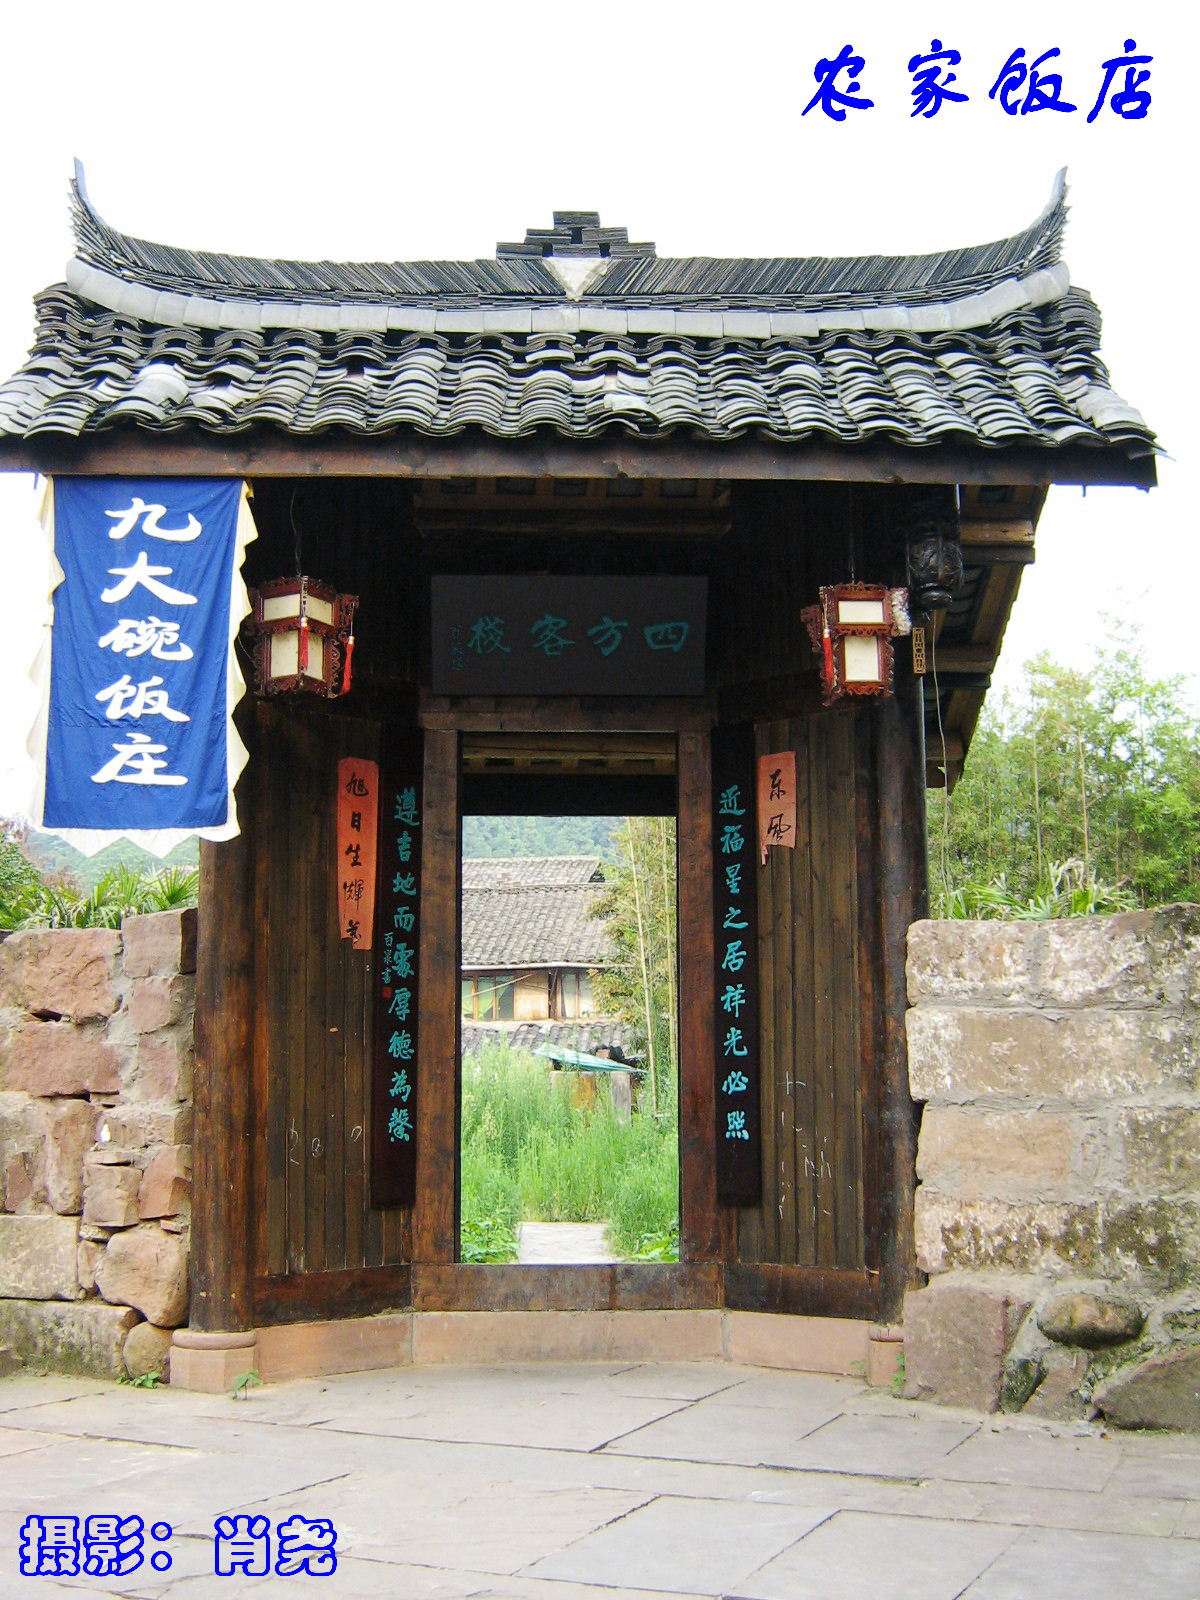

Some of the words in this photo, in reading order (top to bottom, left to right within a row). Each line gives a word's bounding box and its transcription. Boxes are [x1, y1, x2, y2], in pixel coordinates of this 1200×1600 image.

[91, 498, 202, 786] 九大碗饭庄
[719, 784, 751, 1142] 近福星之居祥光必照
